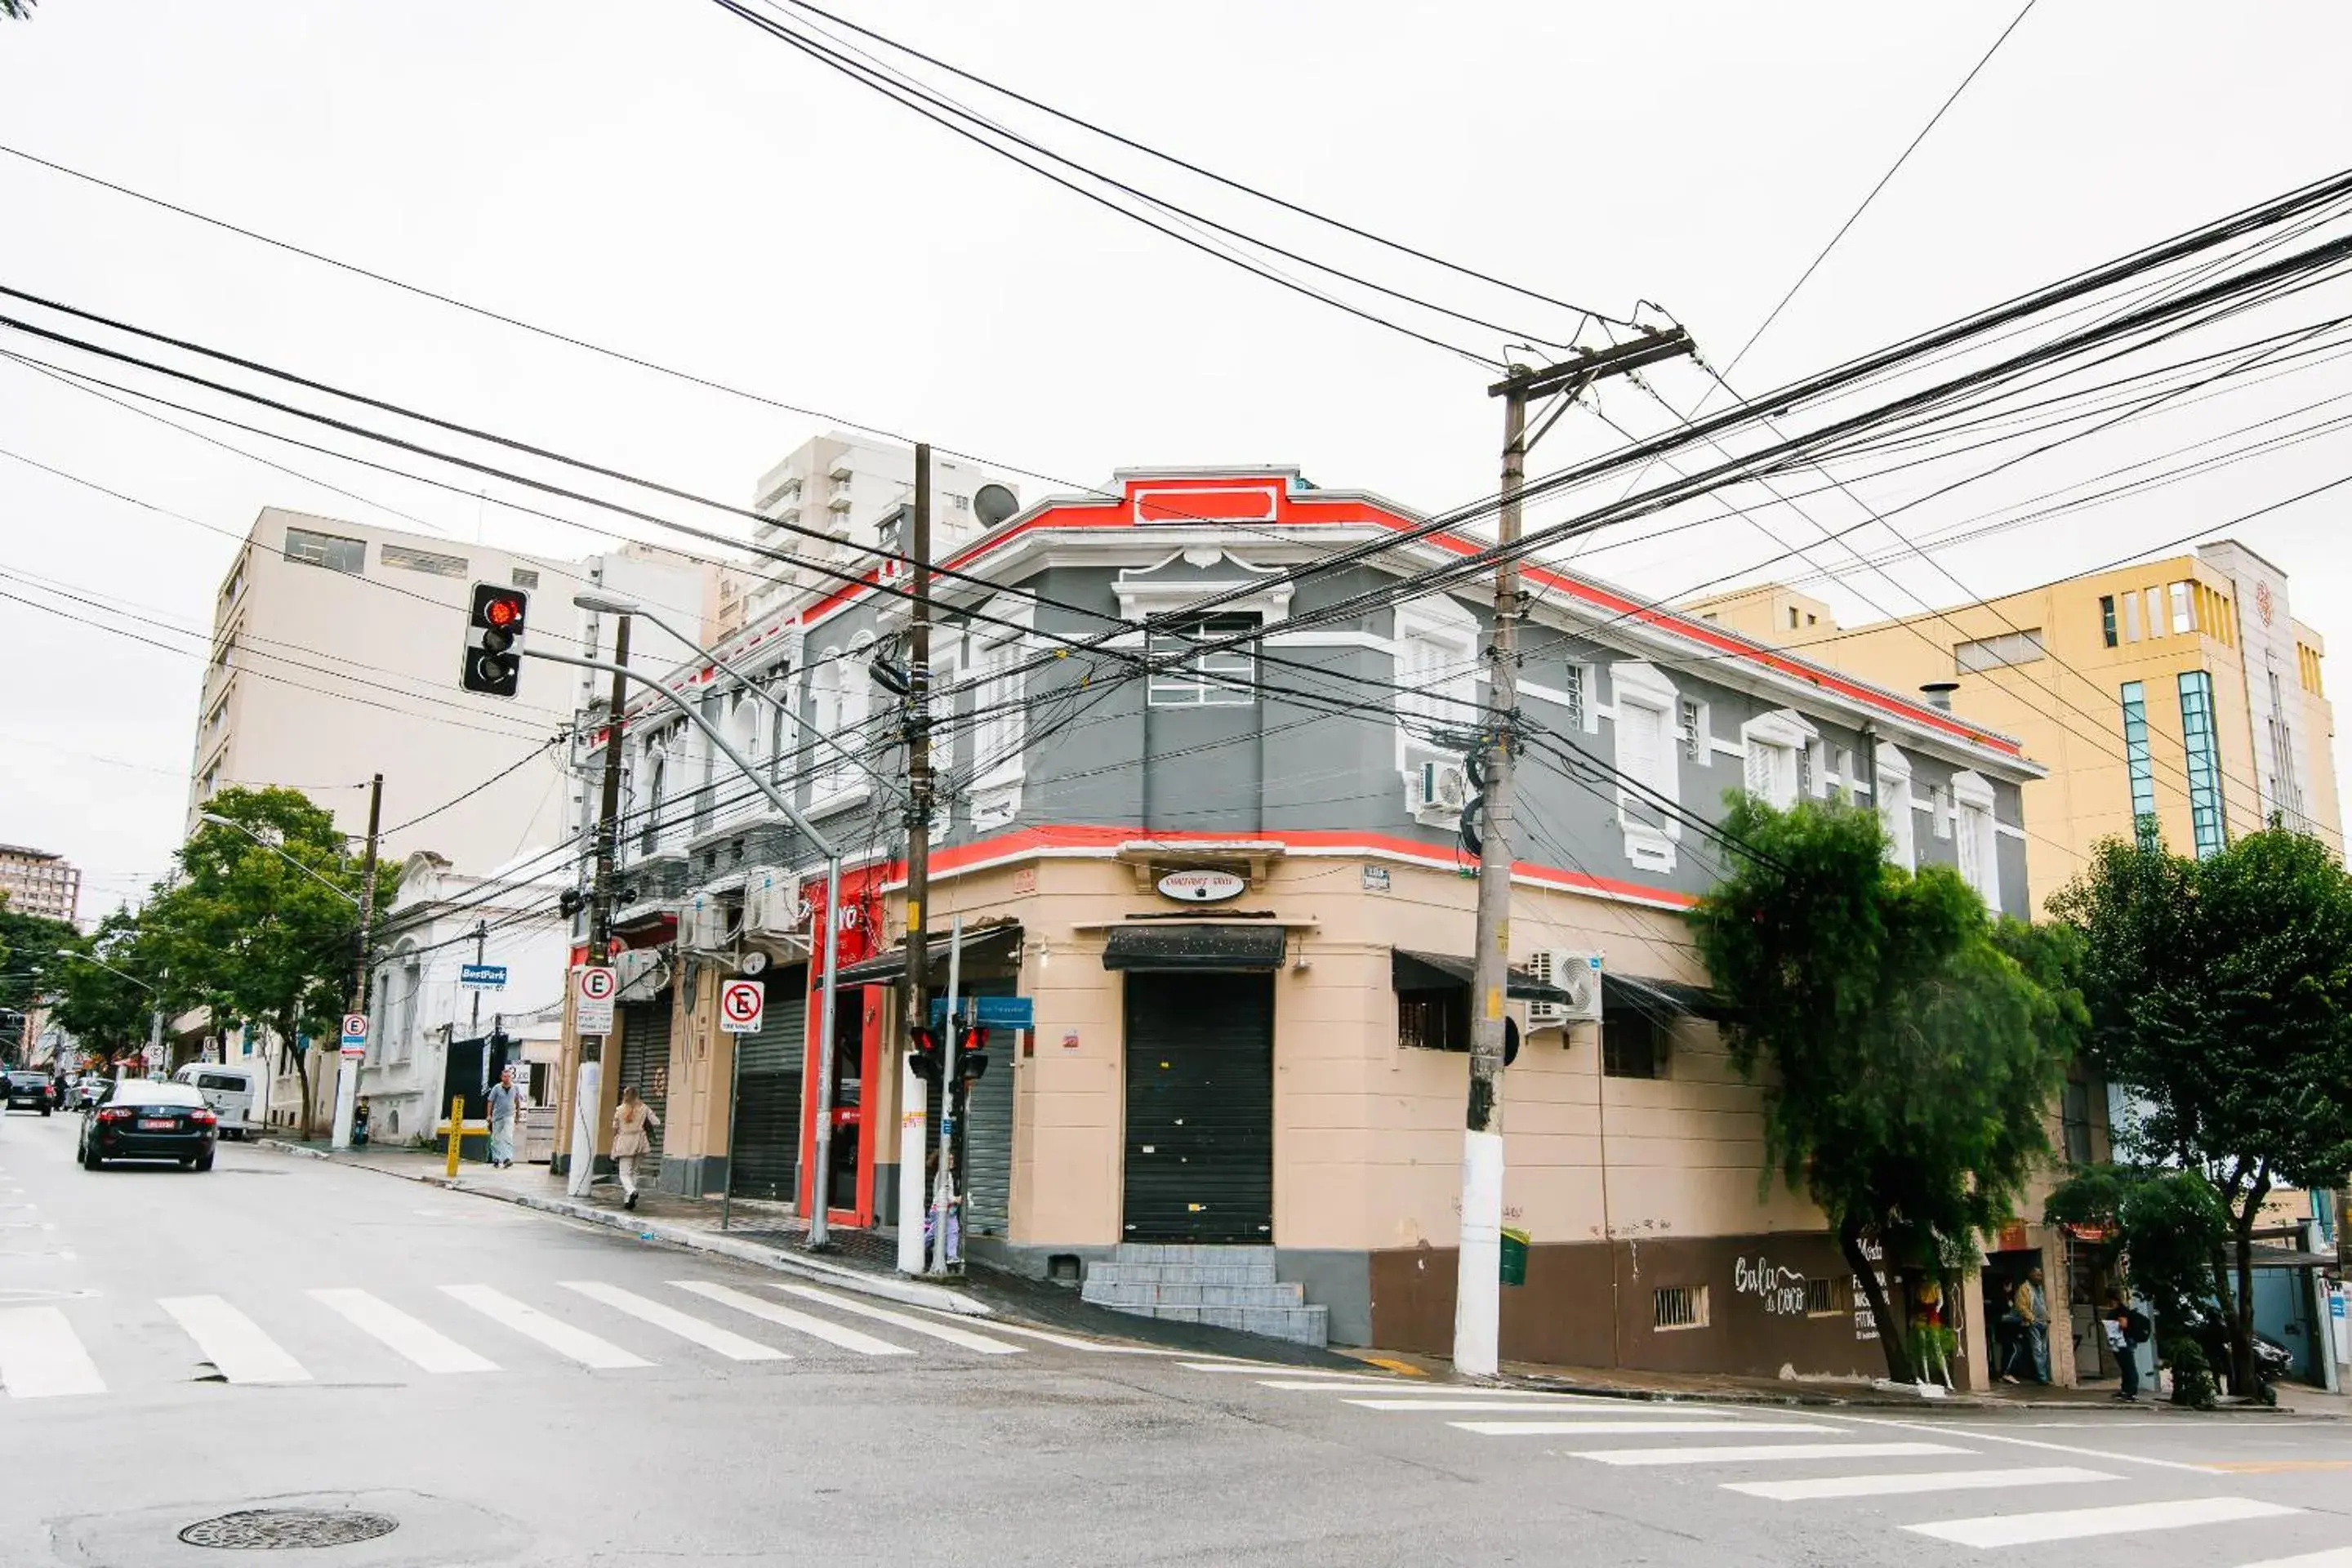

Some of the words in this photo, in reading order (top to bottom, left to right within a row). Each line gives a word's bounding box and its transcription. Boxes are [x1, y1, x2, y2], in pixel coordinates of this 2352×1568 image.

[462, 969, 506, 979] BestPark
[591, 975, 604, 993] E
[737, 991, 750, 1013] E
[350, 1020, 360, 1032] E
[1735, 1257, 1805, 1297] Bala
